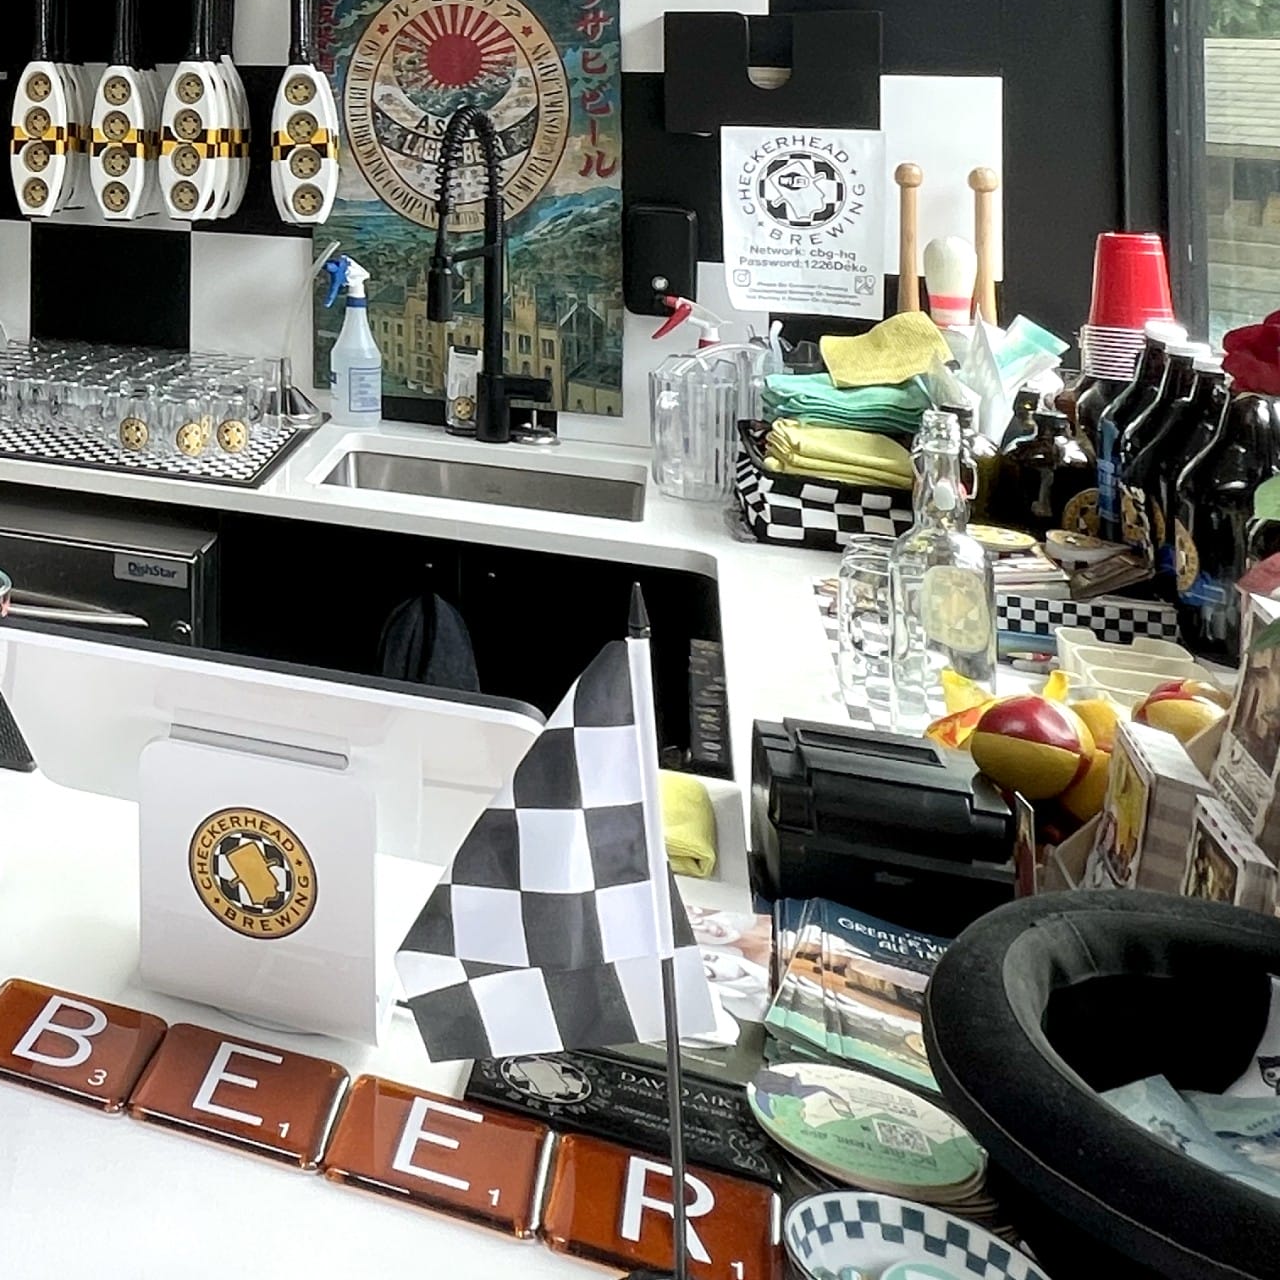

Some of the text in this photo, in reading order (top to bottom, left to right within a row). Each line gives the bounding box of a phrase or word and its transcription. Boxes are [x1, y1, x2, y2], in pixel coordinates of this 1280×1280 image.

[738, 135, 849, 215] CHECKERHEAD
[769, 184, 865, 246] BREWING
[750, 245, 856, 261] Network: cbg-hq
[128, 561, 176, 578] DishStar
[197, 816, 295, 890] CHECKERHEAD
[224, 875, 309, 931] BREWING
[838, 917, 920, 949] GREATER
[879, 941, 909, 955] ALE
